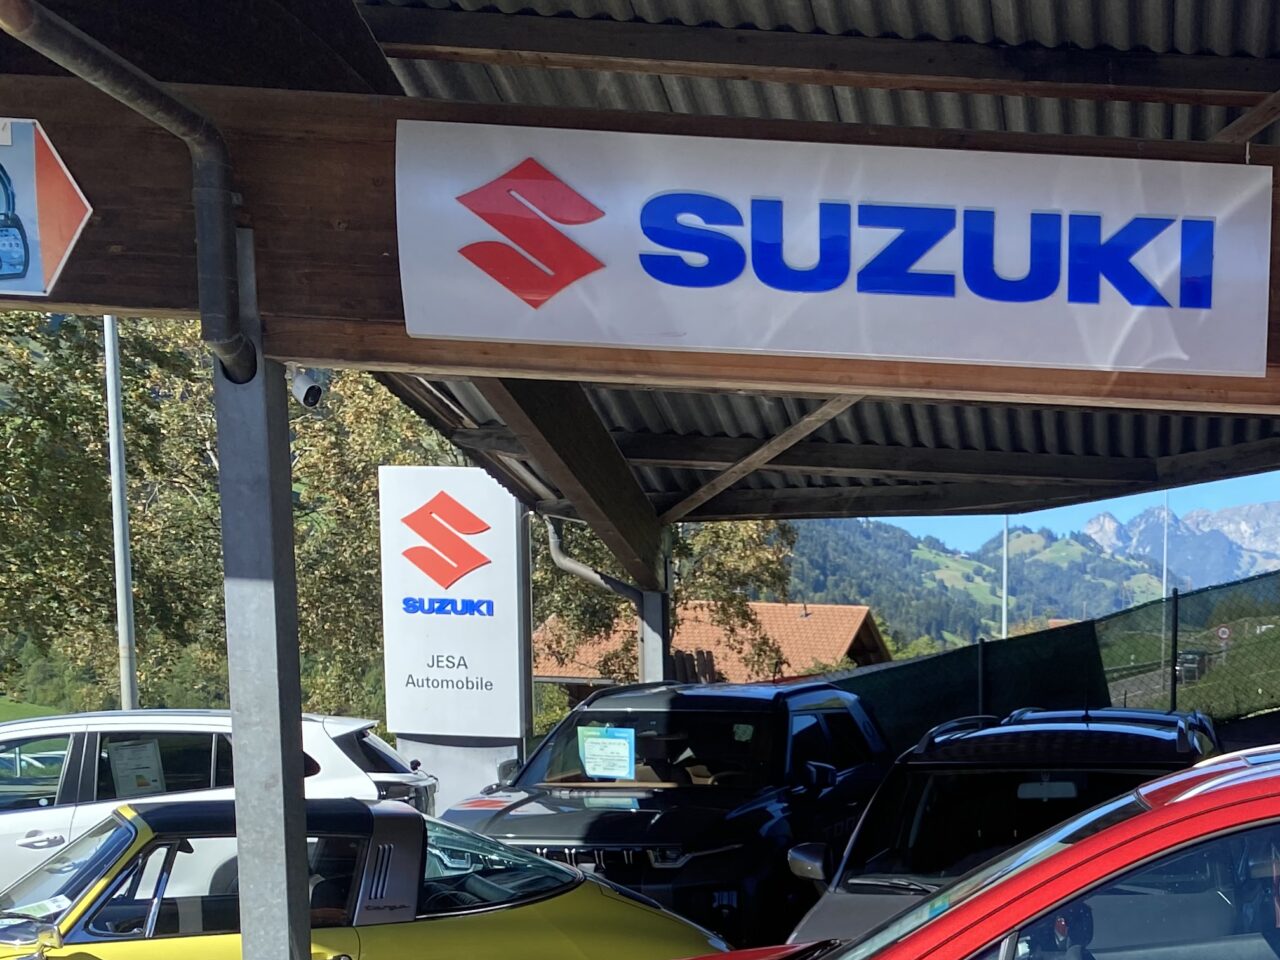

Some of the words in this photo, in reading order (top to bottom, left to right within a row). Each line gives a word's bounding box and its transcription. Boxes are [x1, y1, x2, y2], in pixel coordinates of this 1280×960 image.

[638, 189, 1218, 310] SUZUKI
[402, 596, 495, 617] SUZUKI
[426, 654, 469, 670] JESA
[405, 674, 494, 691] Automobile
